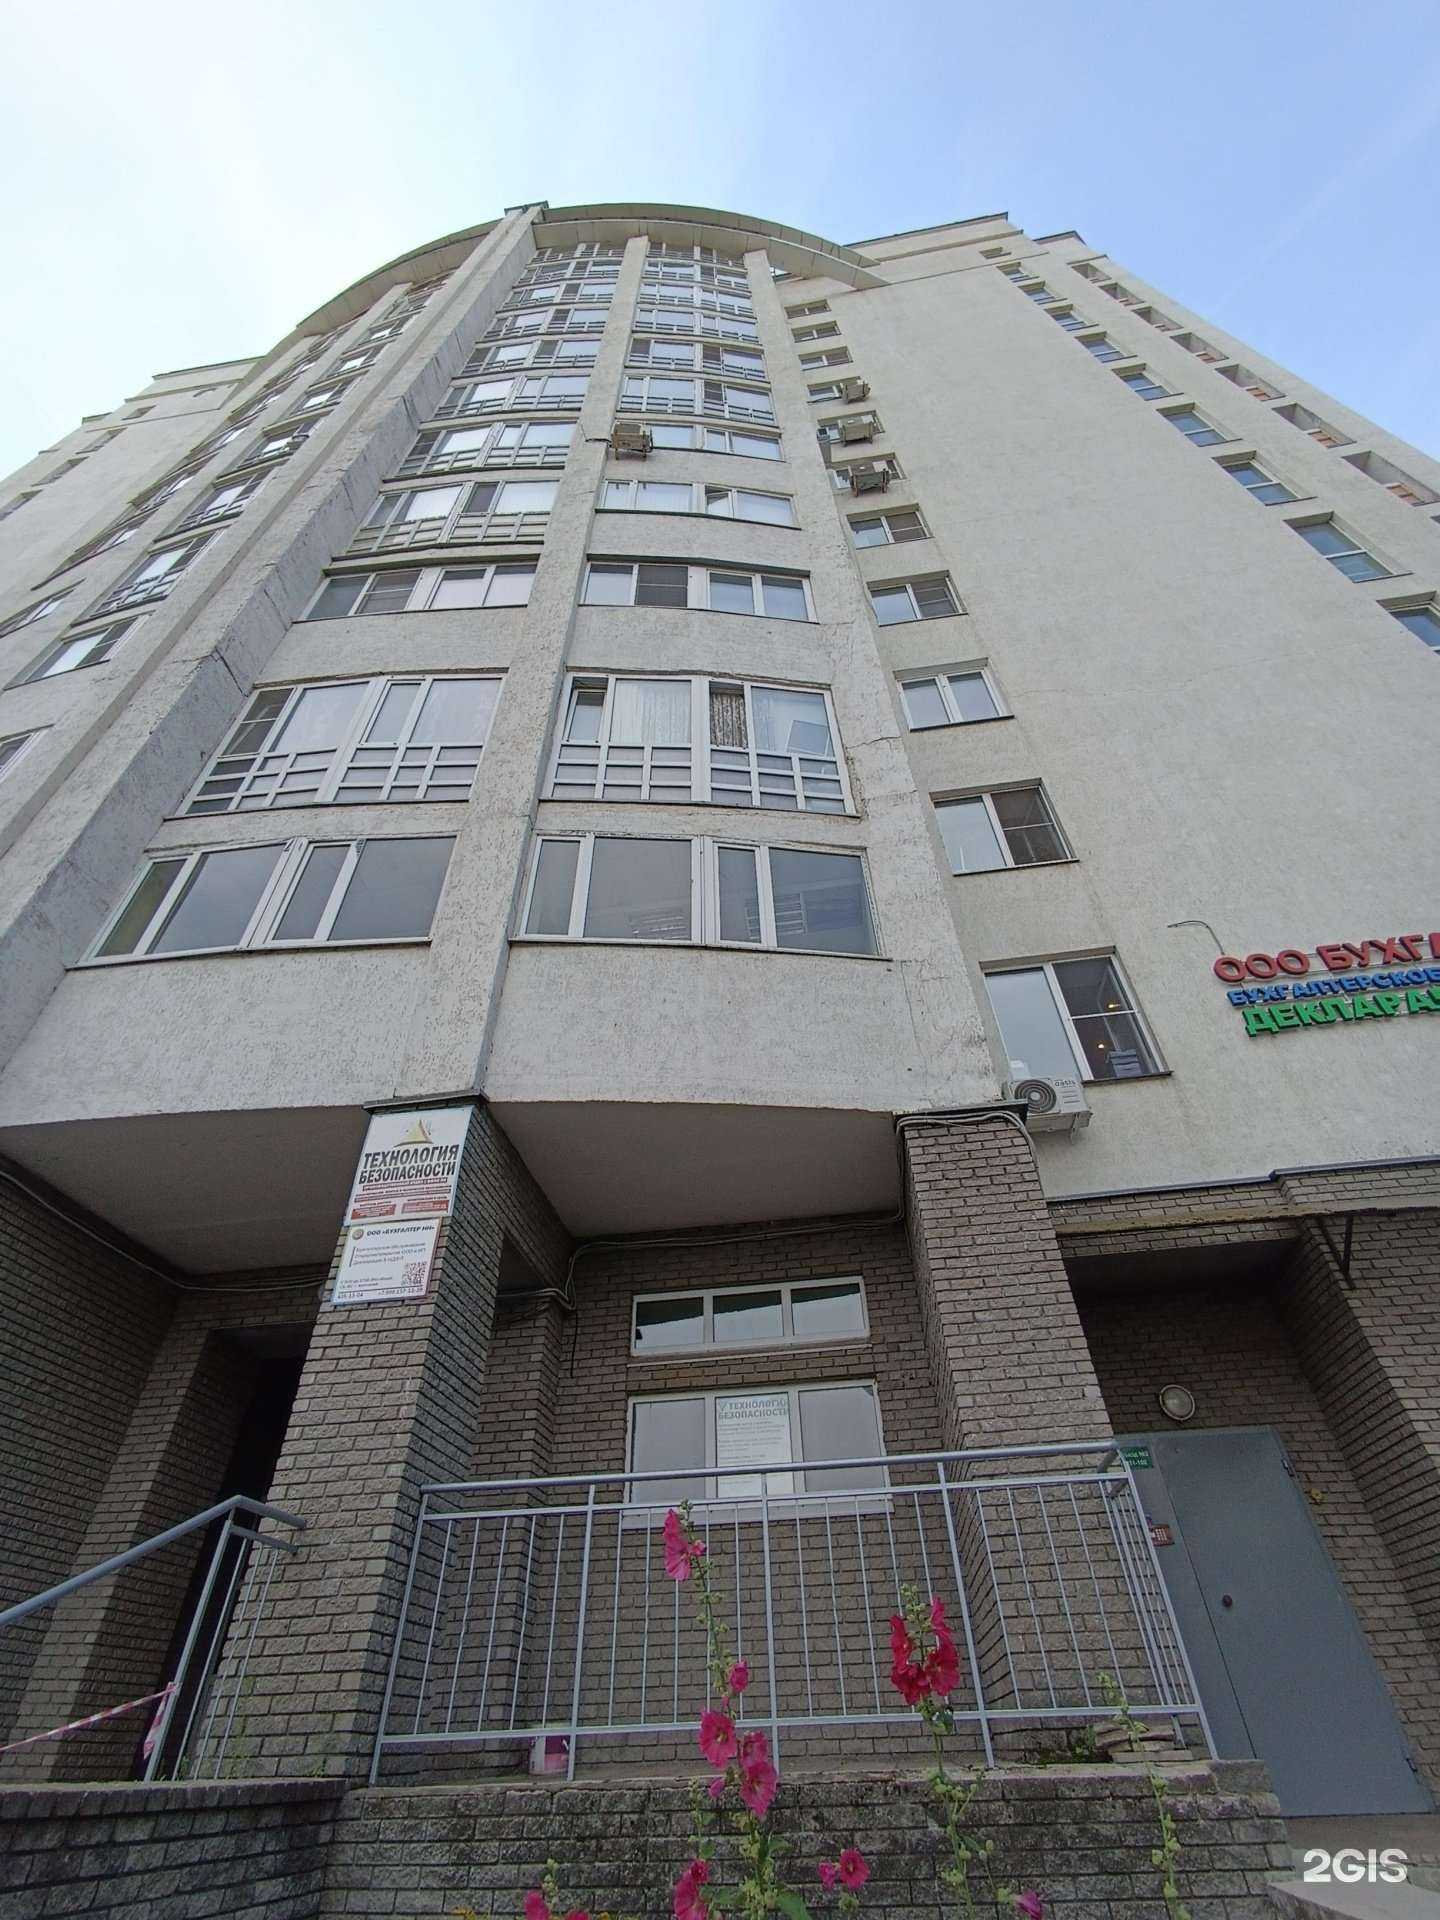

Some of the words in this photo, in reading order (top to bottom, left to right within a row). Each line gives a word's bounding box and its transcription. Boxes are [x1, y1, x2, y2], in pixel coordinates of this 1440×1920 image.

[1214, 949, 1310, 983] ООО
[364, 1144, 459, 1169] ТЕХНОЛОГИЯ
[359, 1161, 456, 1184] БЕЗОПАСНОСТИ
